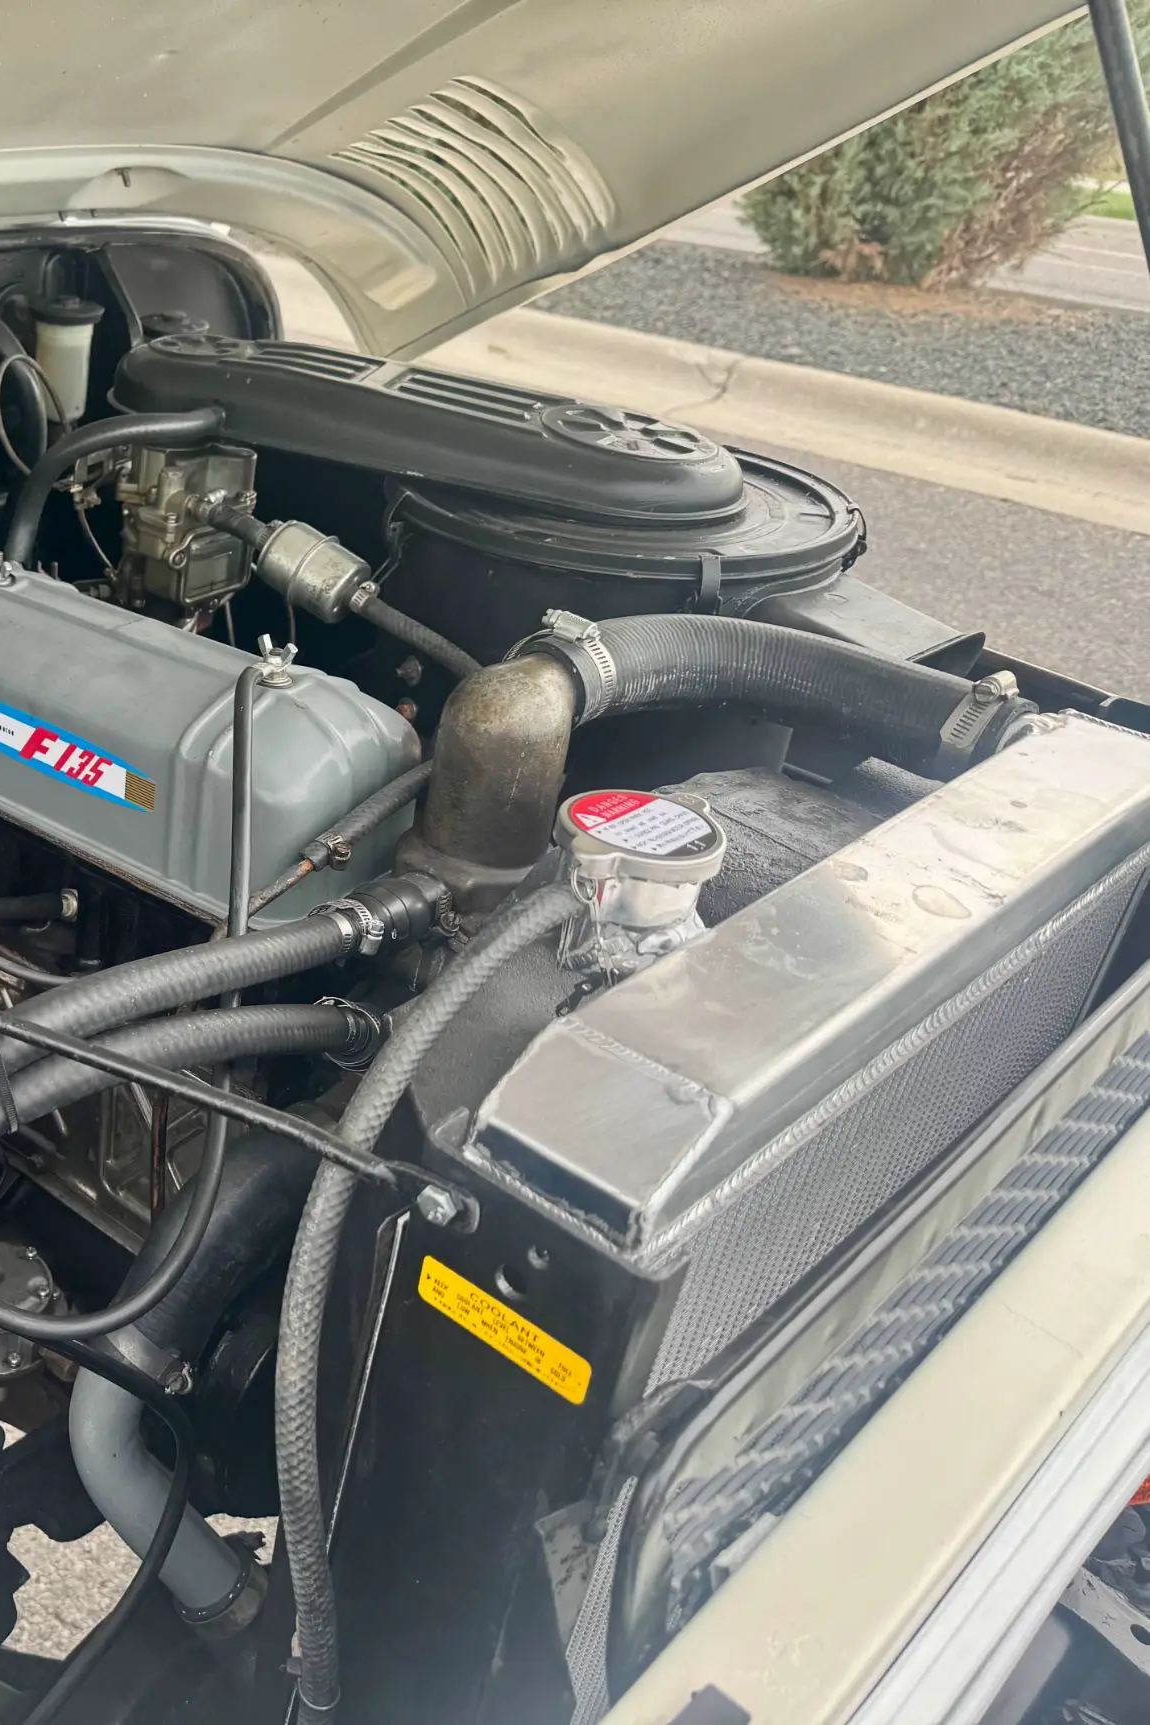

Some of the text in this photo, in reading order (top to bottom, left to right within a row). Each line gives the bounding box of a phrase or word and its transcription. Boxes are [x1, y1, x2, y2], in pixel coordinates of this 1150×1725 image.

[588, 794, 628, 813] DANGER
[601, 799, 641, 820] WARNING
[470, 1292, 539, 1342] COOLANT
